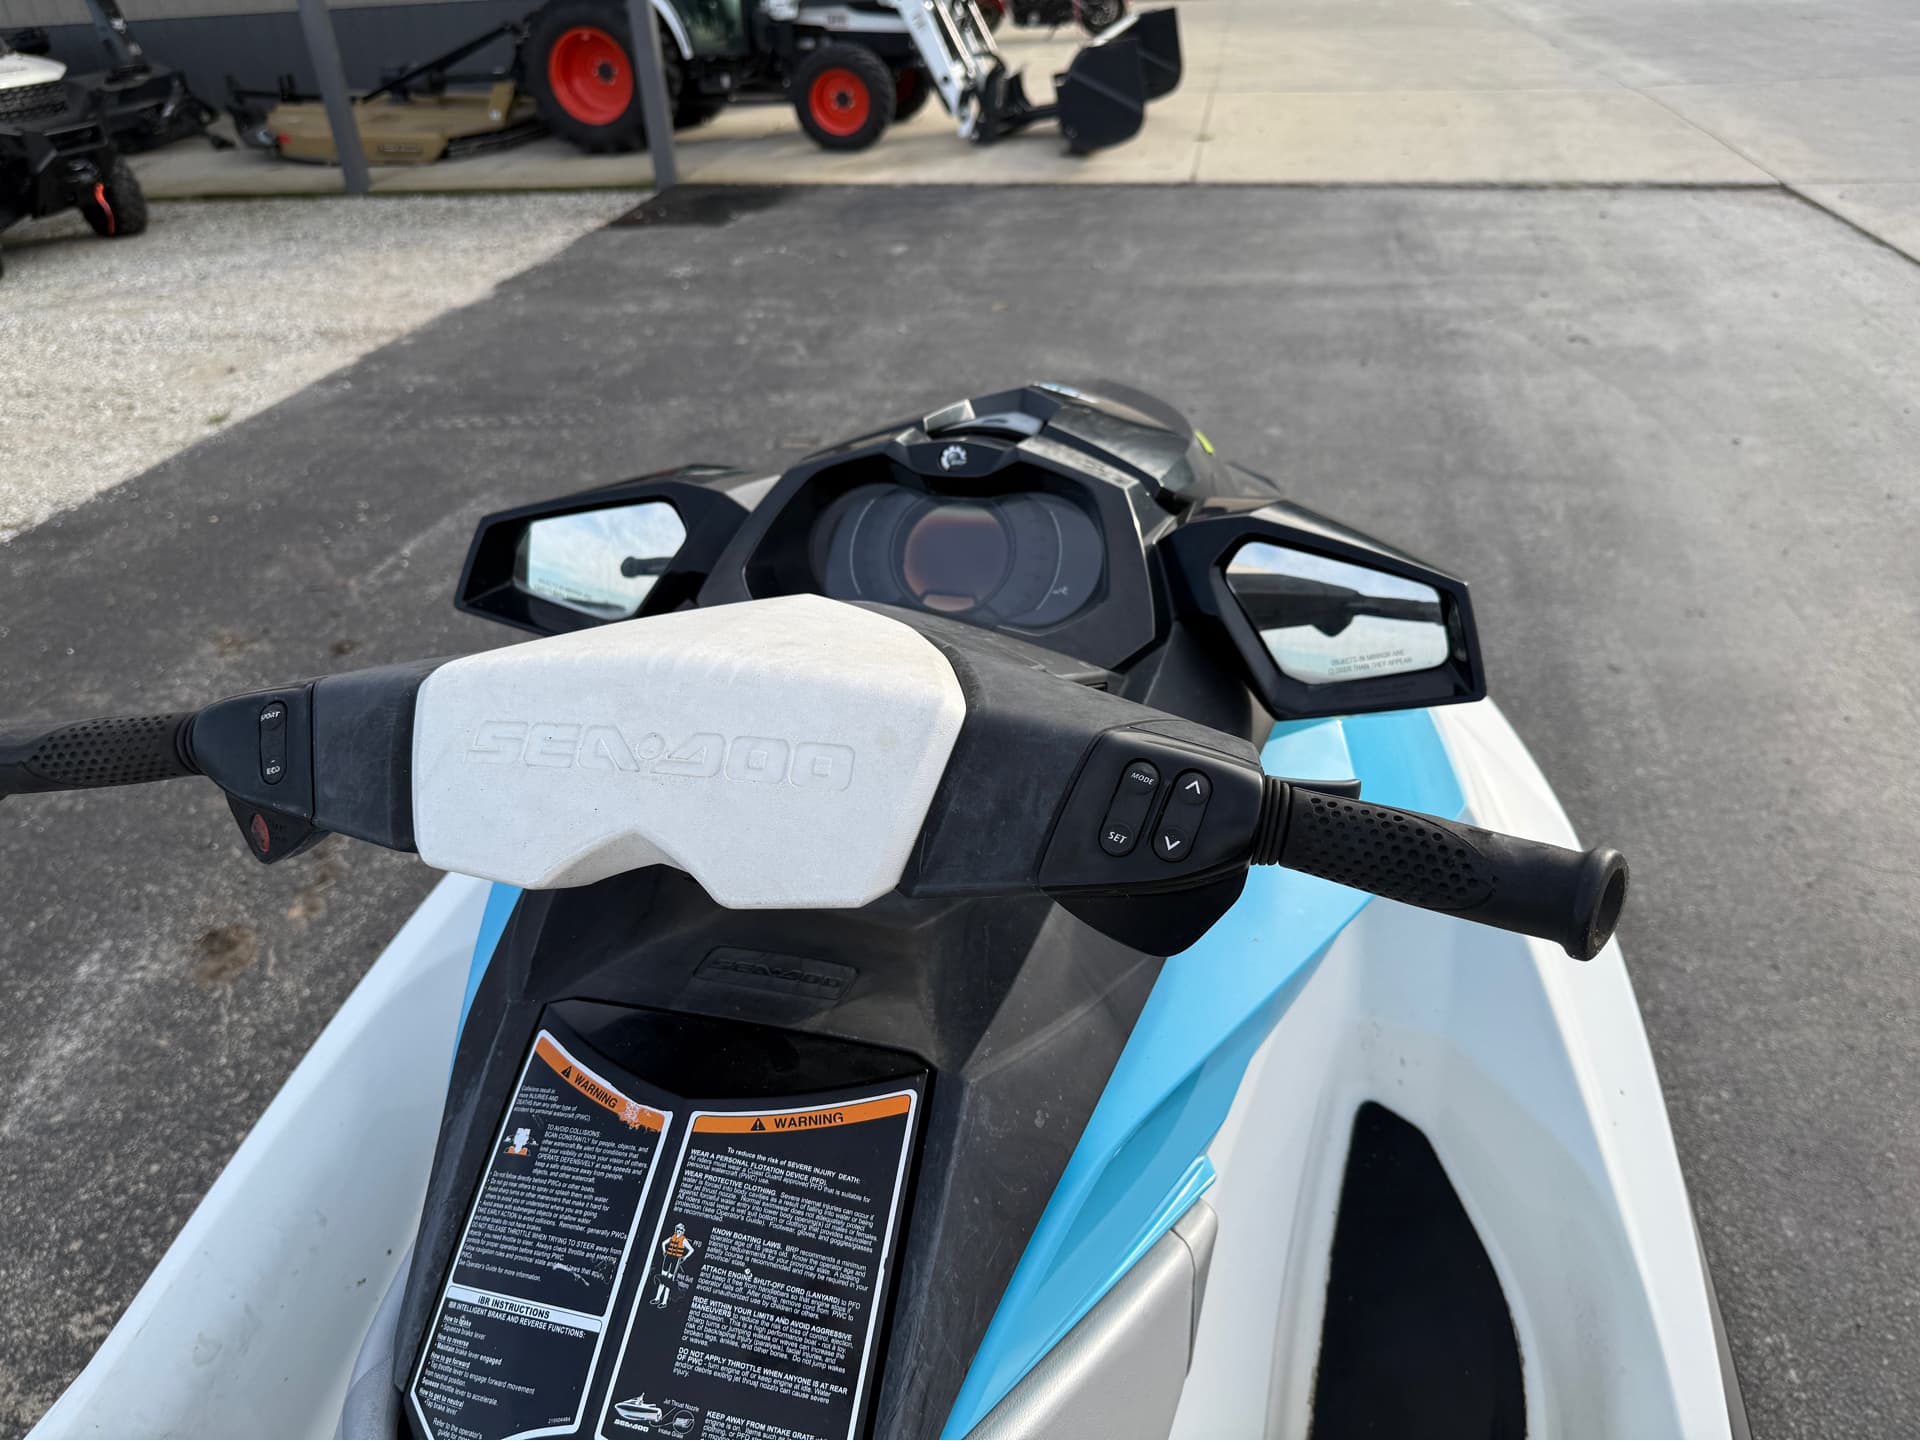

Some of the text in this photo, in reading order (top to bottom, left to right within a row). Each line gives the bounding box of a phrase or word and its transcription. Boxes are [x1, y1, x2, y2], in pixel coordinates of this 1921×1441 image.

[266, 766, 281, 775] ECO
[1130, 772, 1155, 786] MODE
[1108, 831, 1128, 844] SET
[574, 1072, 618, 1109] WARNING
[774, 1112, 844, 1128] WARNING
[690, 1148, 709, 1157] WEAR
[715, 1154, 749, 1166] PERSONAL
[750, 1162, 784, 1175] FLOTATION
[785, 1170, 808, 1180] DEVICE
[735, 1149, 756, 1158] reduce
[767, 1156, 778, 1164] risk
[786, 1161, 812, 1171] SEVERE
[813, 1167, 836, 1177] INJURY
[684, 1169, 703, 1178] WEAR
[704, 1174, 743, 1188] PROTECTIVE
[711, 1227, 732, 1237] KNOW
[732, 1232, 761, 1244] BOATING
[785, 1245, 799, 1253] BRP
[701, 1264, 726, 1275] ATTACH
[727, 1270, 752, 1282] ENGINE
[752, 1277, 785, 1290] SHUT-OFF
[785, 1285, 805, 1295] CORD
[805, 1290, 840, 1304] (LANYARD)
[847, 1300, 860, 1309] PFD
[491, 1298, 550, 1319] INSTRUCTIONS
[690, 1302, 731, 1317] MANEUVERS
[692, 1295, 852, 1341] RIDE WITHIN YOUR LIMITS AND AVOID AGGRESSIVE
[487, 1309, 506, 1320] BRAKE
[505, 1314, 519, 1323] AND
[519, 1316, 546, 1329] REVERSE
[547, 1323, 586, 1338] FUNCTIONS:
[676, 1353, 686, 1361] OF
[686, 1355, 703, 1365] PWC
[678, 1346, 848, 1394] DO NOT APPLY THROTTLE WHEN ANYONE IS AT REAR
[684, 1403, 700, 1412] Nozzle
[706, 1410, 726, 1420] KEEP
[725, 1415, 746, 1426] AWAY
[746, 1420, 766, 1432] FROM
[766, 1425, 792, 1437] INTAKE
